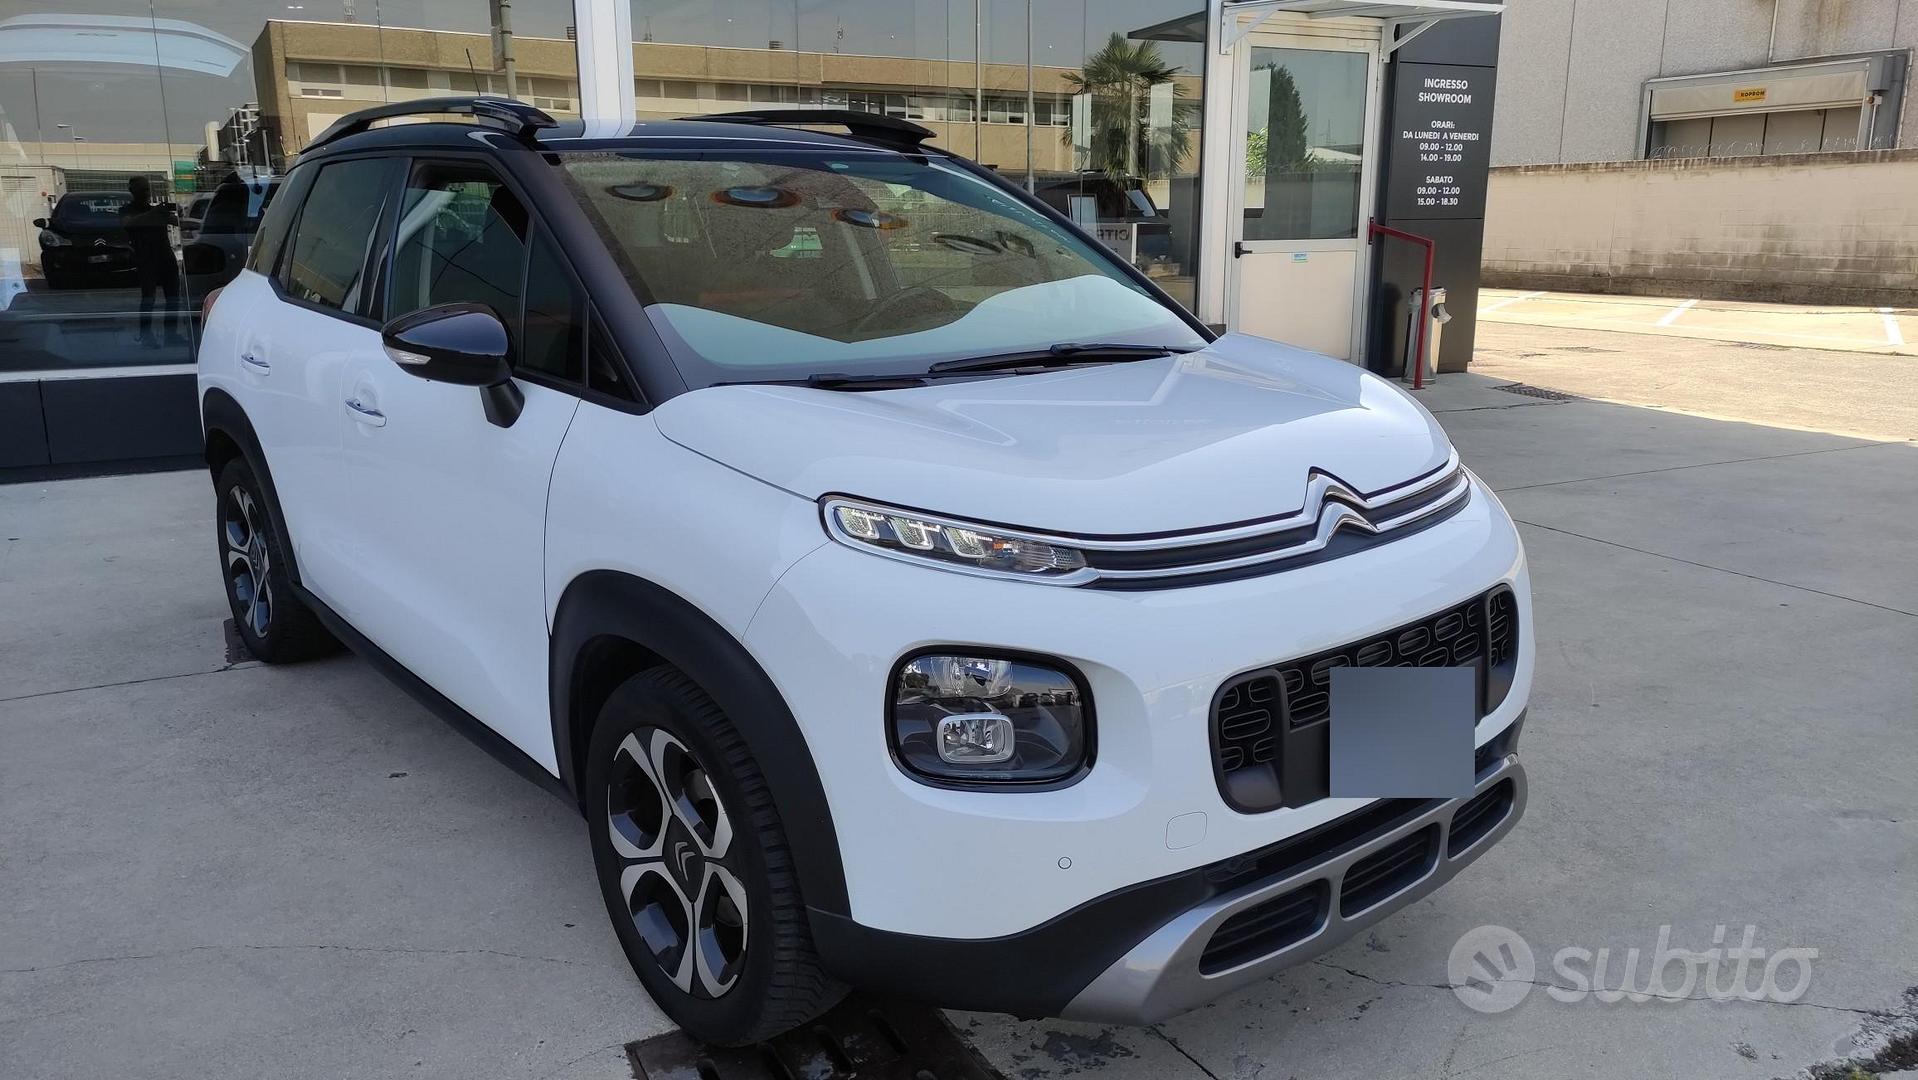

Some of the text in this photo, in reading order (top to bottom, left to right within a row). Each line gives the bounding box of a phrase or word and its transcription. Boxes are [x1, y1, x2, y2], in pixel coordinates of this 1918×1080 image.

[1424, 78, 1468, 90] INGRESSO
[1418, 92, 1472, 104] SHOWROOM
[1431, 120, 1455, 129] ORARI:
[1403, 130, 1413, 139] DA
[1442, 132, 1448, 140] A
[1419, 142, 1439, 151] 09.00
[1445, 143, 1463, 151] 12.00
[1420, 153, 1438, 162] 14.00
[1444, 153, 1462, 162] 19.00
[1426, 175, 1453, 184] SABATO
[1417, 186, 1437, 195] 09.00
[1442, 186, 1461, 195] 12.00
[1417, 197, 1436, 206] 15.00
[1441, 197, 1459, 206] 18.30
